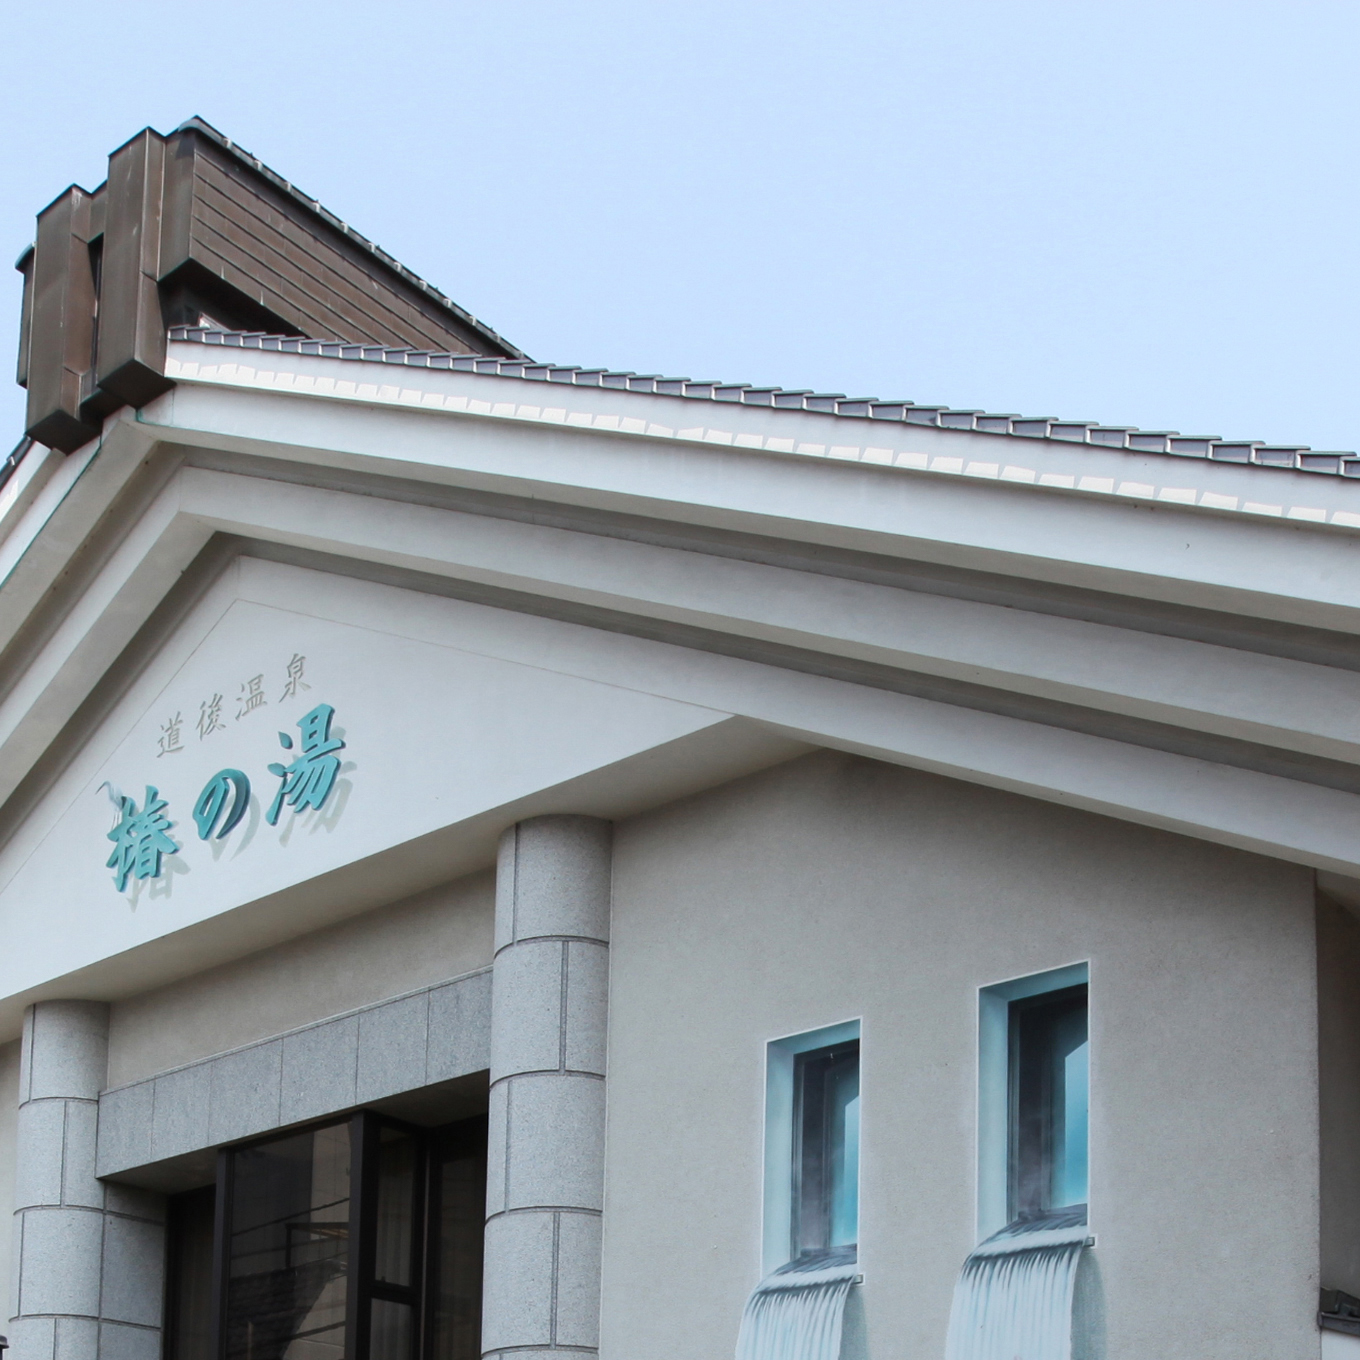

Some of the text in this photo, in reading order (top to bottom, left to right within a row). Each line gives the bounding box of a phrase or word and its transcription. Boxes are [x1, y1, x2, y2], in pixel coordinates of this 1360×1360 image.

[156, 652, 312, 759] 道後温泉
[105, 702, 346, 893] 椿の湯
